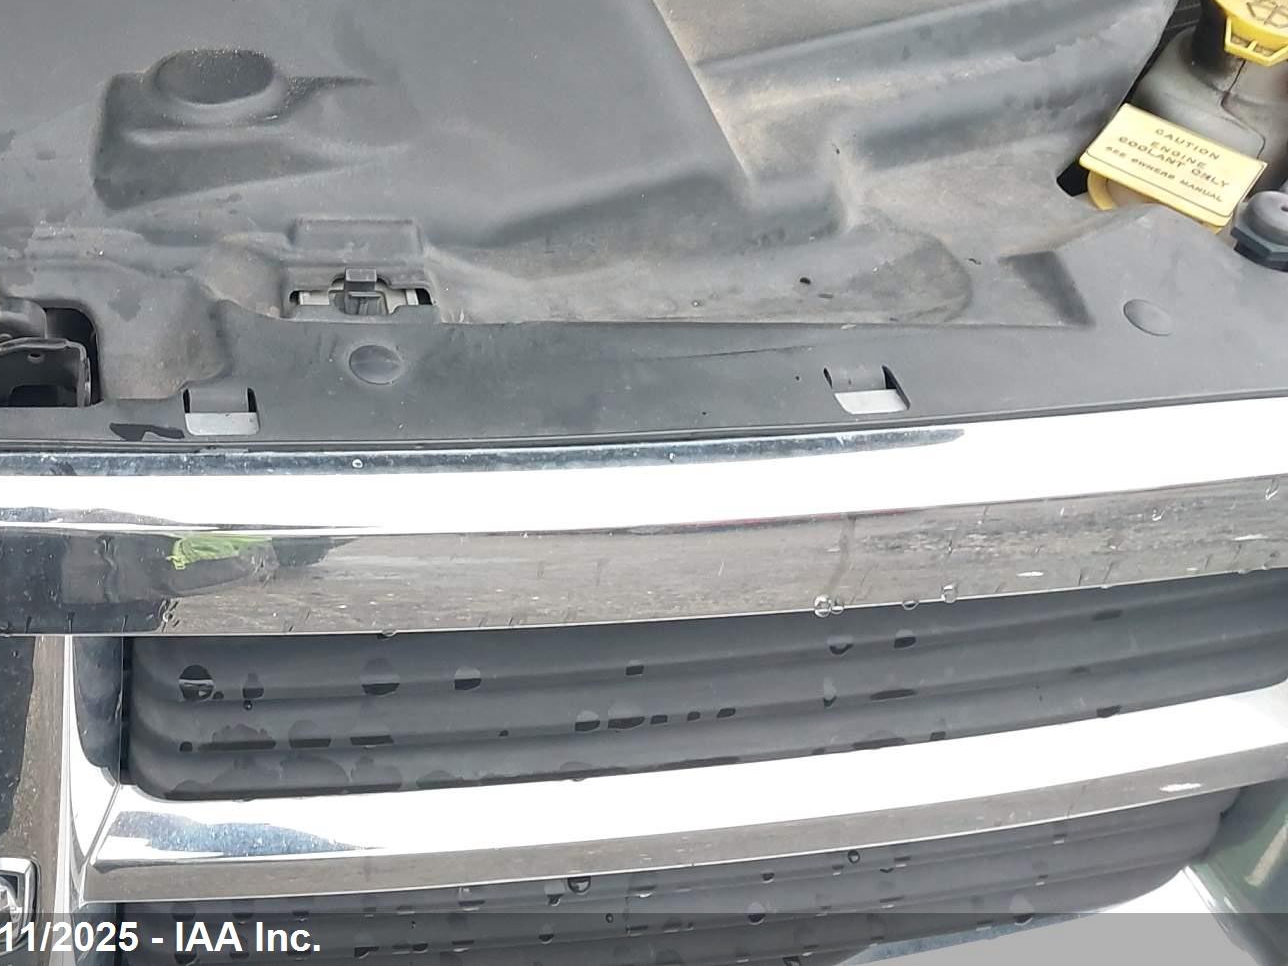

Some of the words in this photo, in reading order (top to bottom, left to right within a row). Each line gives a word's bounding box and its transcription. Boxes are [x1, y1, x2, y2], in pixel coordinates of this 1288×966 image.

[1150, 141, 1208, 169] ENGINE
[1154, 128, 1221, 160] CAUTION
[1118, 136, 1187, 168] COOLANT
[1191, 168, 1230, 188] ONLY
[1179, 179, 1224, 203] MANUAL
